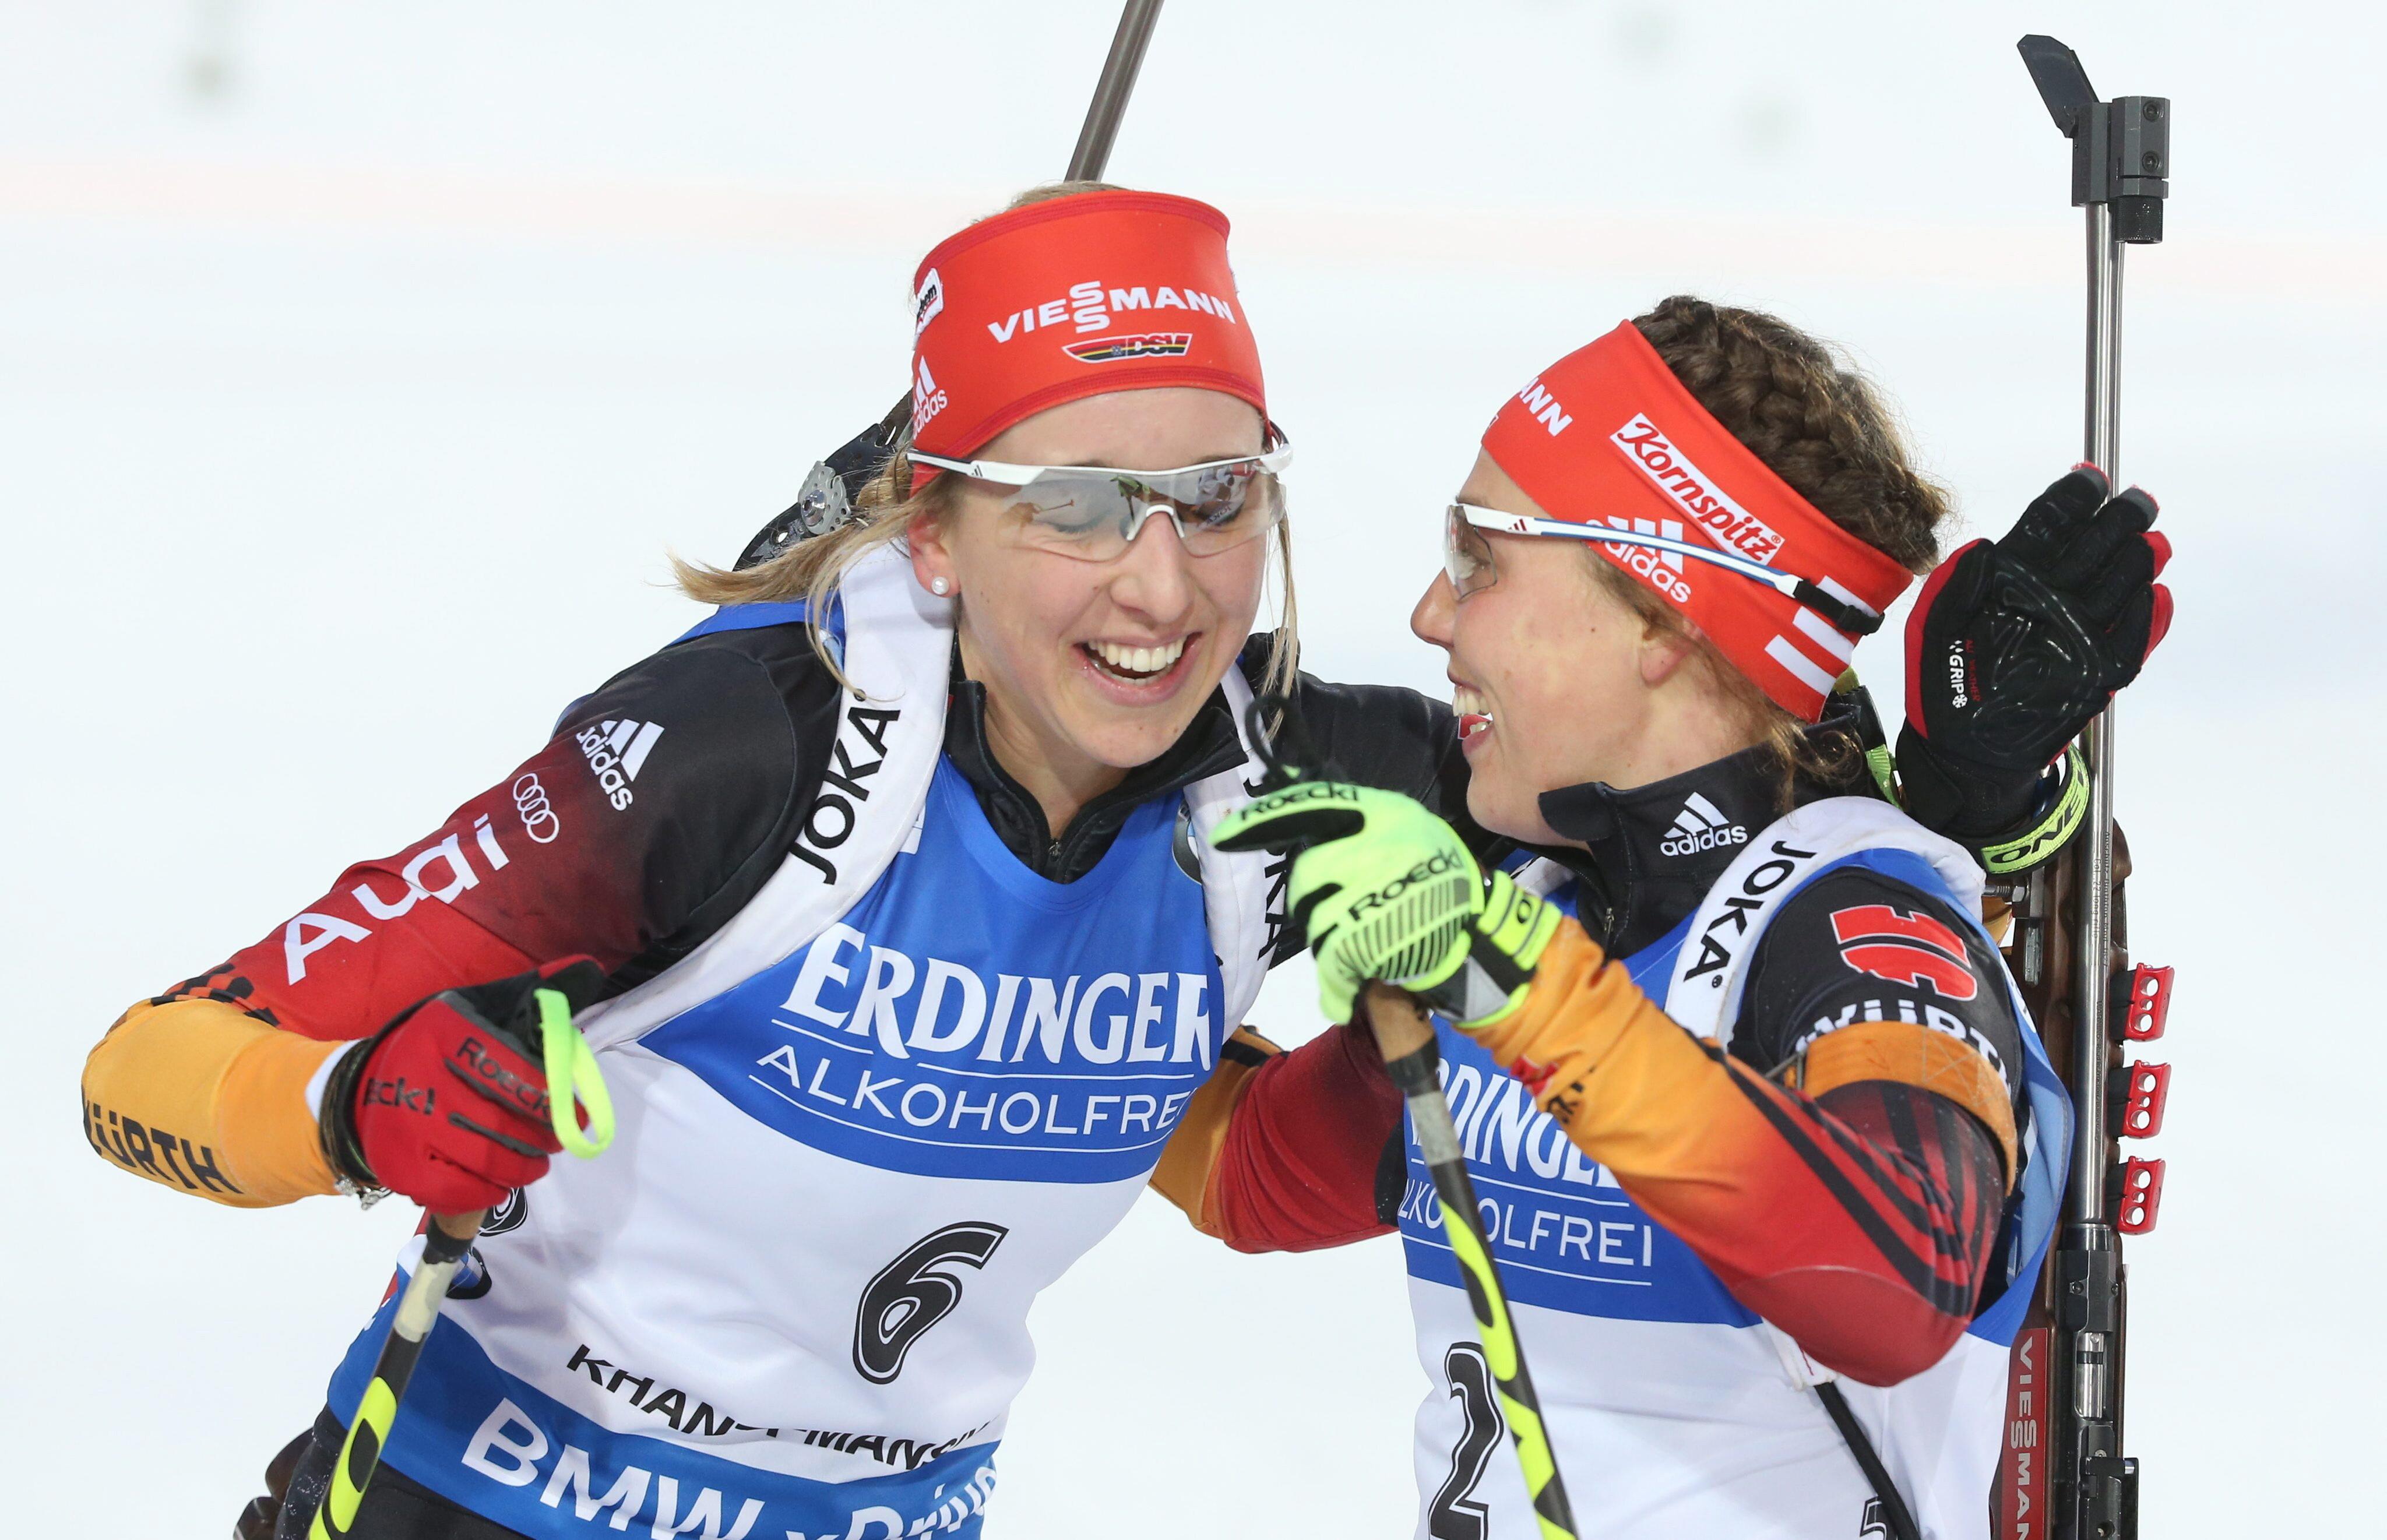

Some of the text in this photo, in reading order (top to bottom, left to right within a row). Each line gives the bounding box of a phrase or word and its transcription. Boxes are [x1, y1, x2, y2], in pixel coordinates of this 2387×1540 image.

[1127, 333, 1193, 357] DSV
[1586, 519, 1691, 603] didas
[1617, 422, 1777, 562] Kornspitz
[1949, 654, 1964, 694] GRIP
[788, 707, 901, 885] JOKA
[1660, 825, 1748, 857] adidas
[284, 813, 510, 986] Audi
[1684, 841, 1817, 982] JOKA
[780, 922, 1211, 1071] ERDINGER
[456, 1037, 551, 1118] Roeck
[1412, 1056, 1622, 1190] DING
[1399, 1178, 1652, 1267] LKOOLFREI
[852, 1221, 1009, 1385] 6
[462, 1397, 765, 1540] BMW
[1428, 1341, 1504, 1540] 2
[2011, 1335, 2037, 1540] VIESSMAN
